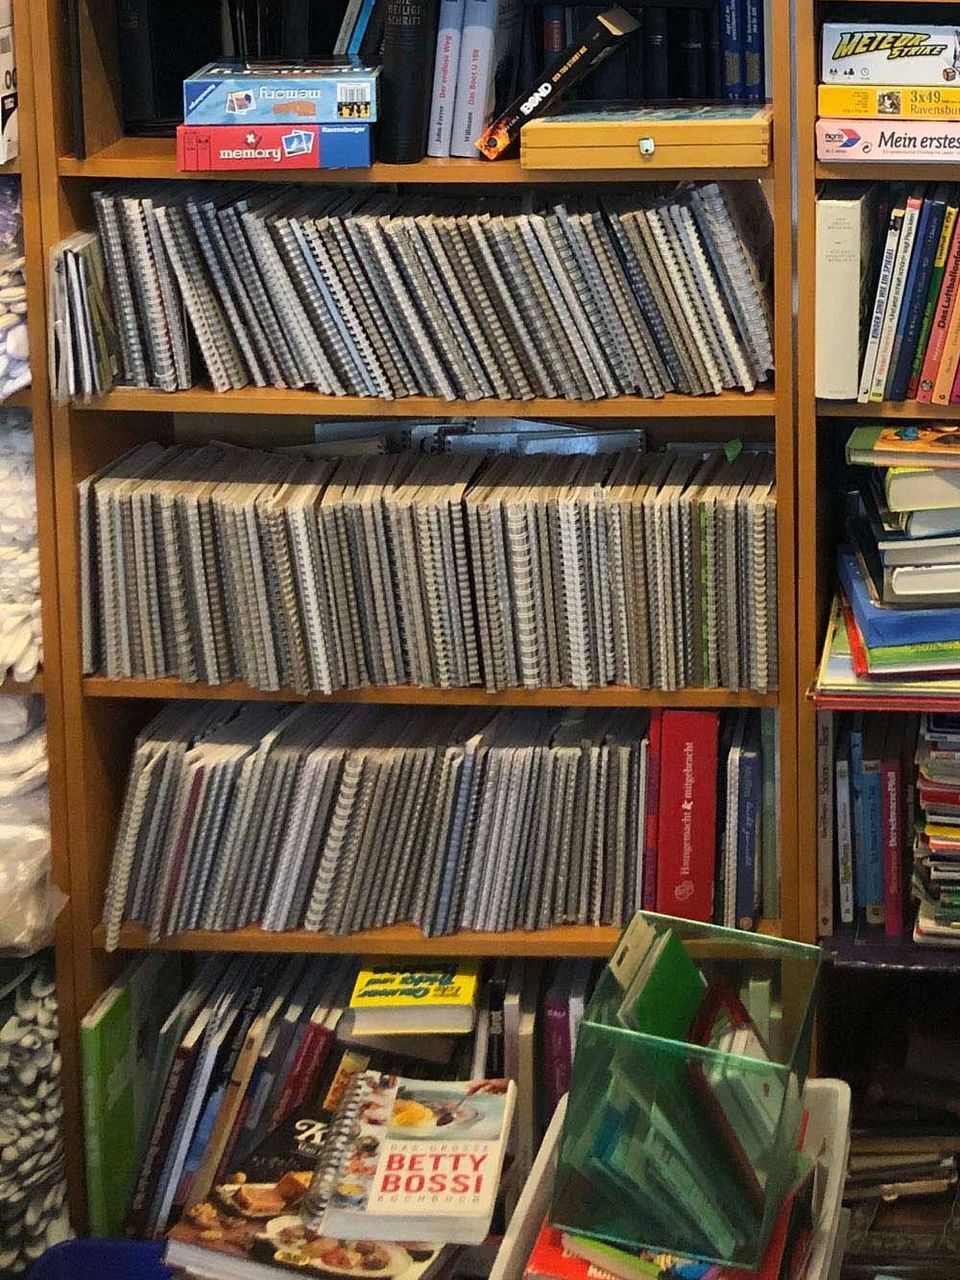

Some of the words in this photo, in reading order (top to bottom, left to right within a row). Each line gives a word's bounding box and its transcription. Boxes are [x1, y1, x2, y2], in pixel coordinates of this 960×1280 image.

[443, 35, 454, 52] Weg
[832, 30, 931, 60] METEOR
[887, 43, 948, 60] STRIKE
[440, 53, 450, 83] endlose
[469, 71, 477, 89] Boot
[259, 86, 322, 100] memory
[438, 84, 446, 98] Der
[467, 90, 476, 104] Das
[518, 80, 554, 116] BOND
[910, 91, 941, 104] 3x49
[878, 131, 917, 149] Mein
[219, 147, 282, 162] memory
[883, 248, 894, 273] SPIEGEL
[880, 273, 890, 285] EIN
[878, 286, 887, 297] WIE
[875, 298, 885, 313] SIND
[870, 314, 882, 338] KINDER
[936, 307, 949, 328] Das
[682, 742, 693, 797] mitgebracht
[887, 771, 895, 790] Pfeil
[681, 812, 692, 874] Hausgemacht
[888, 830, 896, 846] Der
[385, 1153, 489, 1172] BETTY
[380, 1174, 484, 1194] BOSSI
